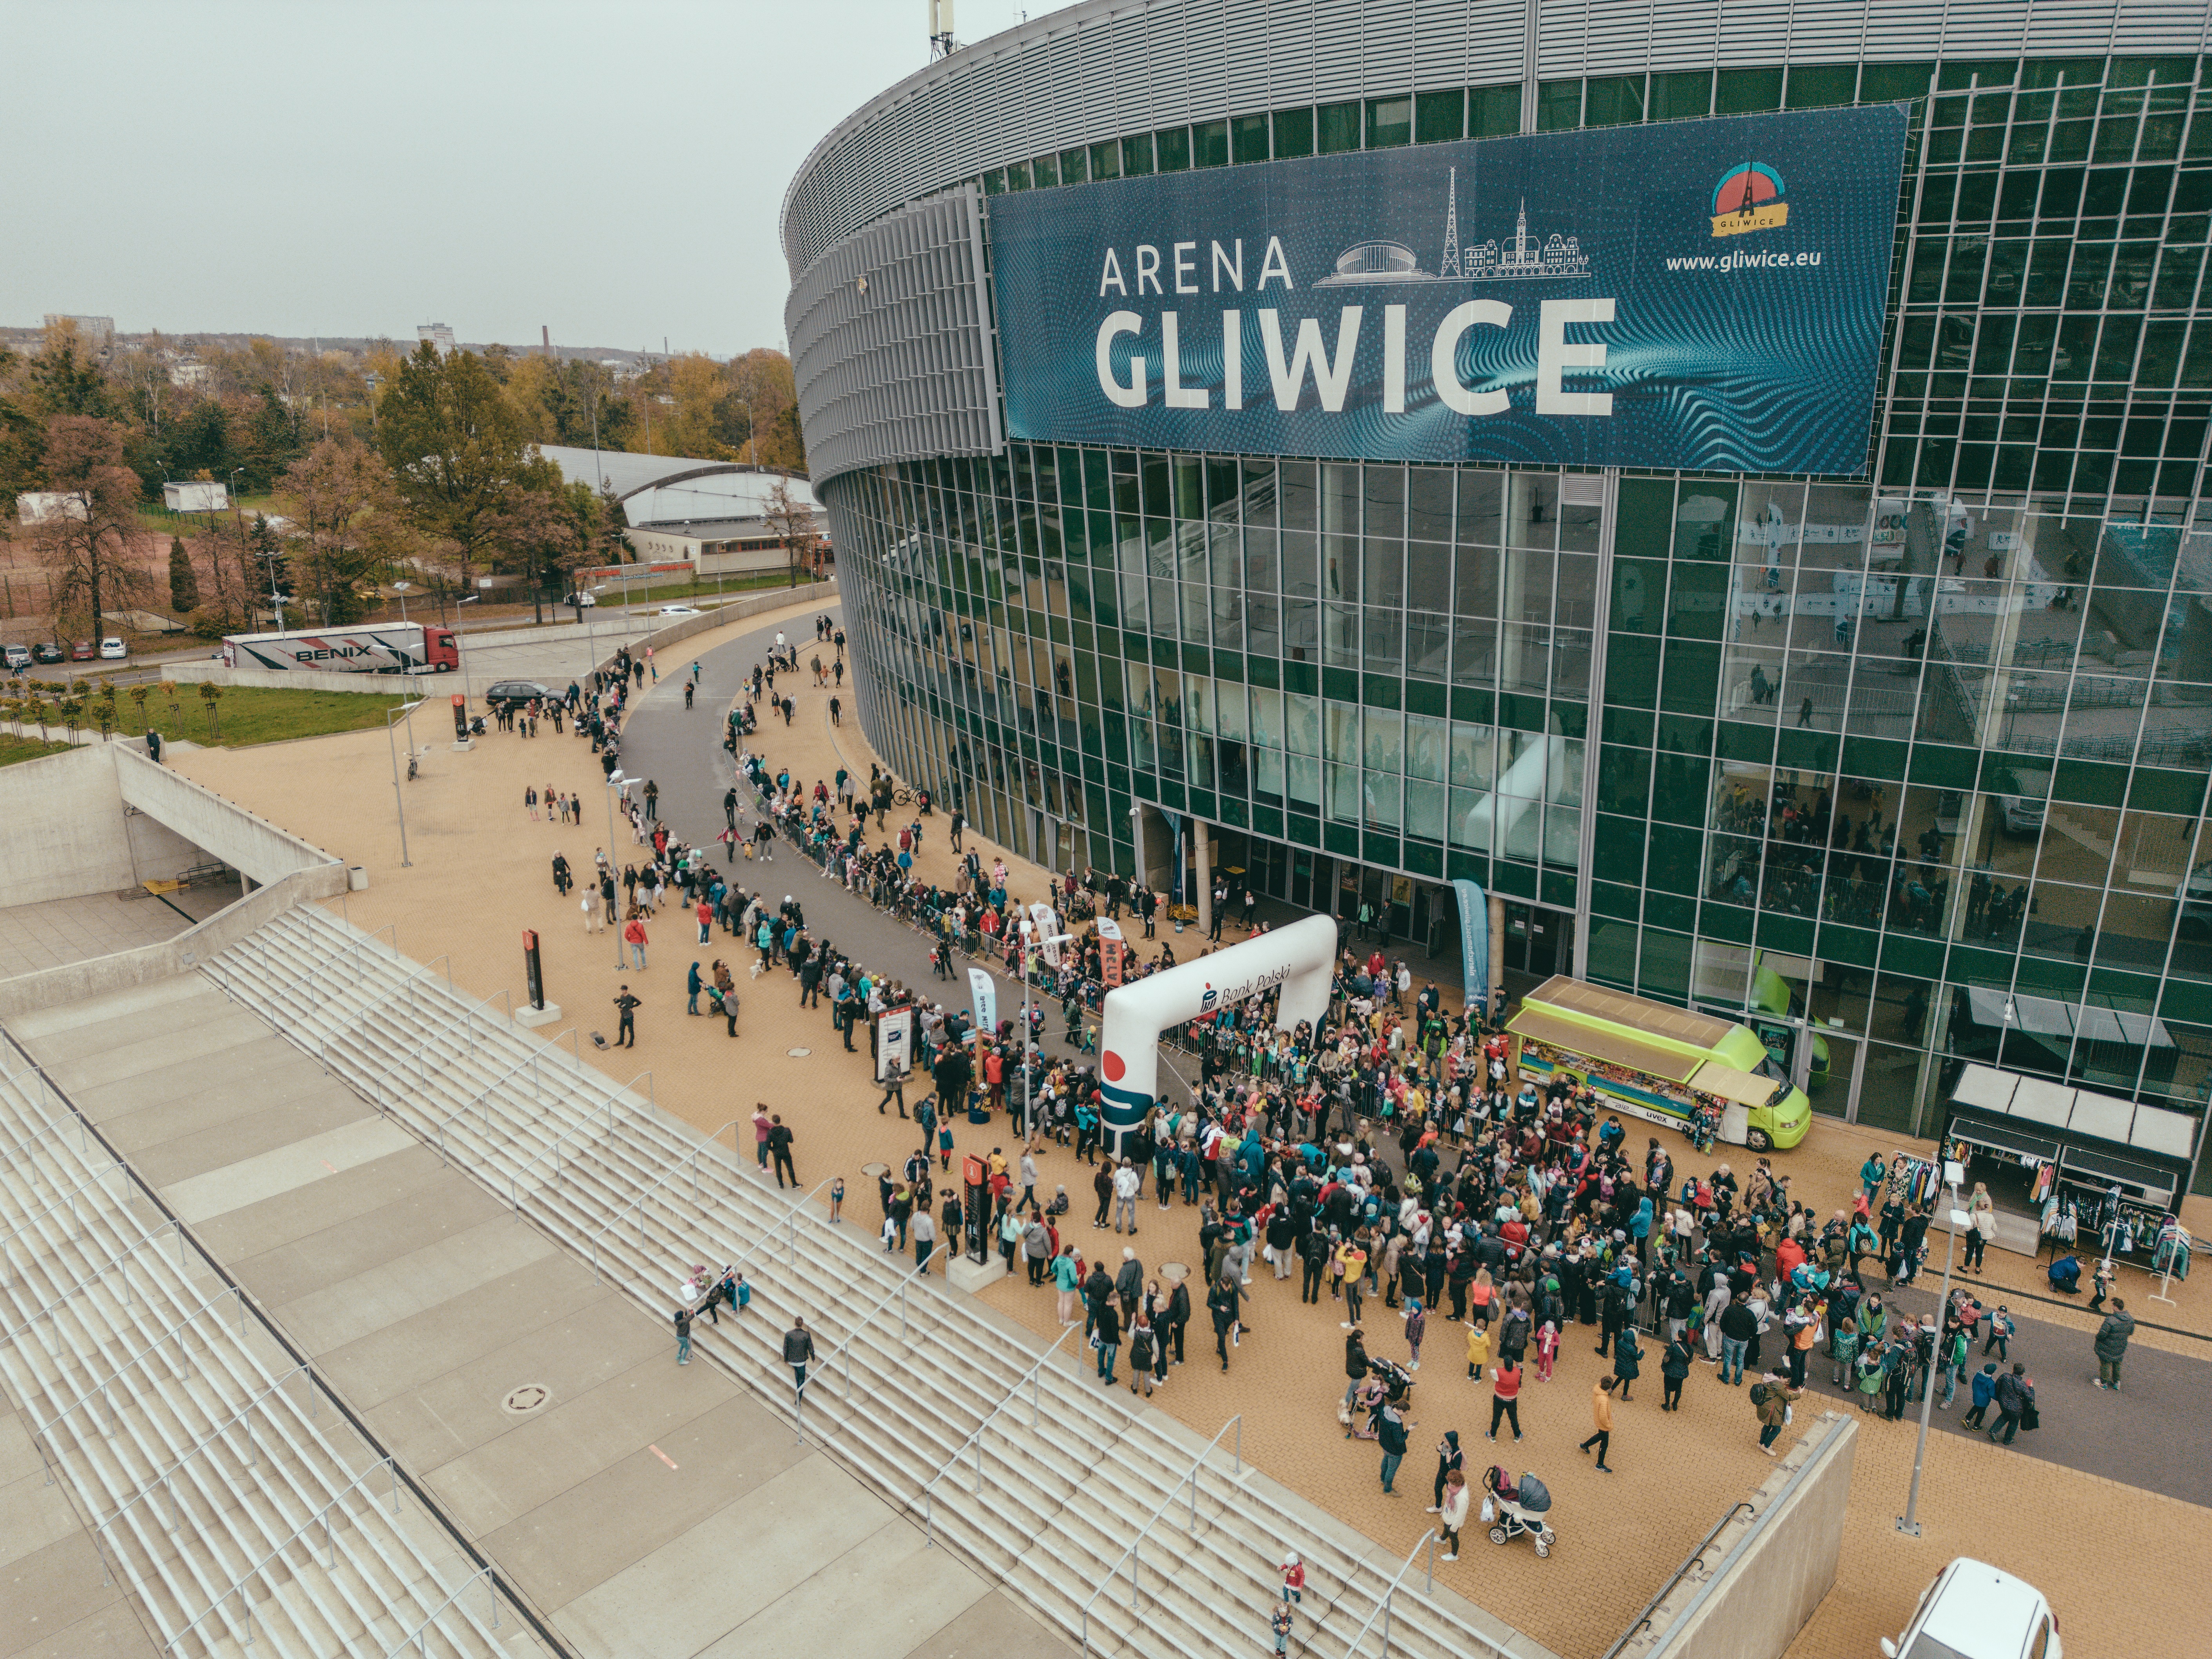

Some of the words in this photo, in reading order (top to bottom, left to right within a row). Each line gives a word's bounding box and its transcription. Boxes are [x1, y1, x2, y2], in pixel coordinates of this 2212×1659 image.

[1721, 218, 1774, 228] GLIWICE
[1099, 235, 1294, 297] ARENA
[1666, 250, 1821, 273] www.gliwice.eu
[1095, 298, 1615, 416] GLIWICE
[296, 645, 372, 662] BENIX
[1221, 980, 1253, 1004] Bank
[1255, 964, 1290, 991] Polski
[1646, 1111, 1667, 1123] uvex
